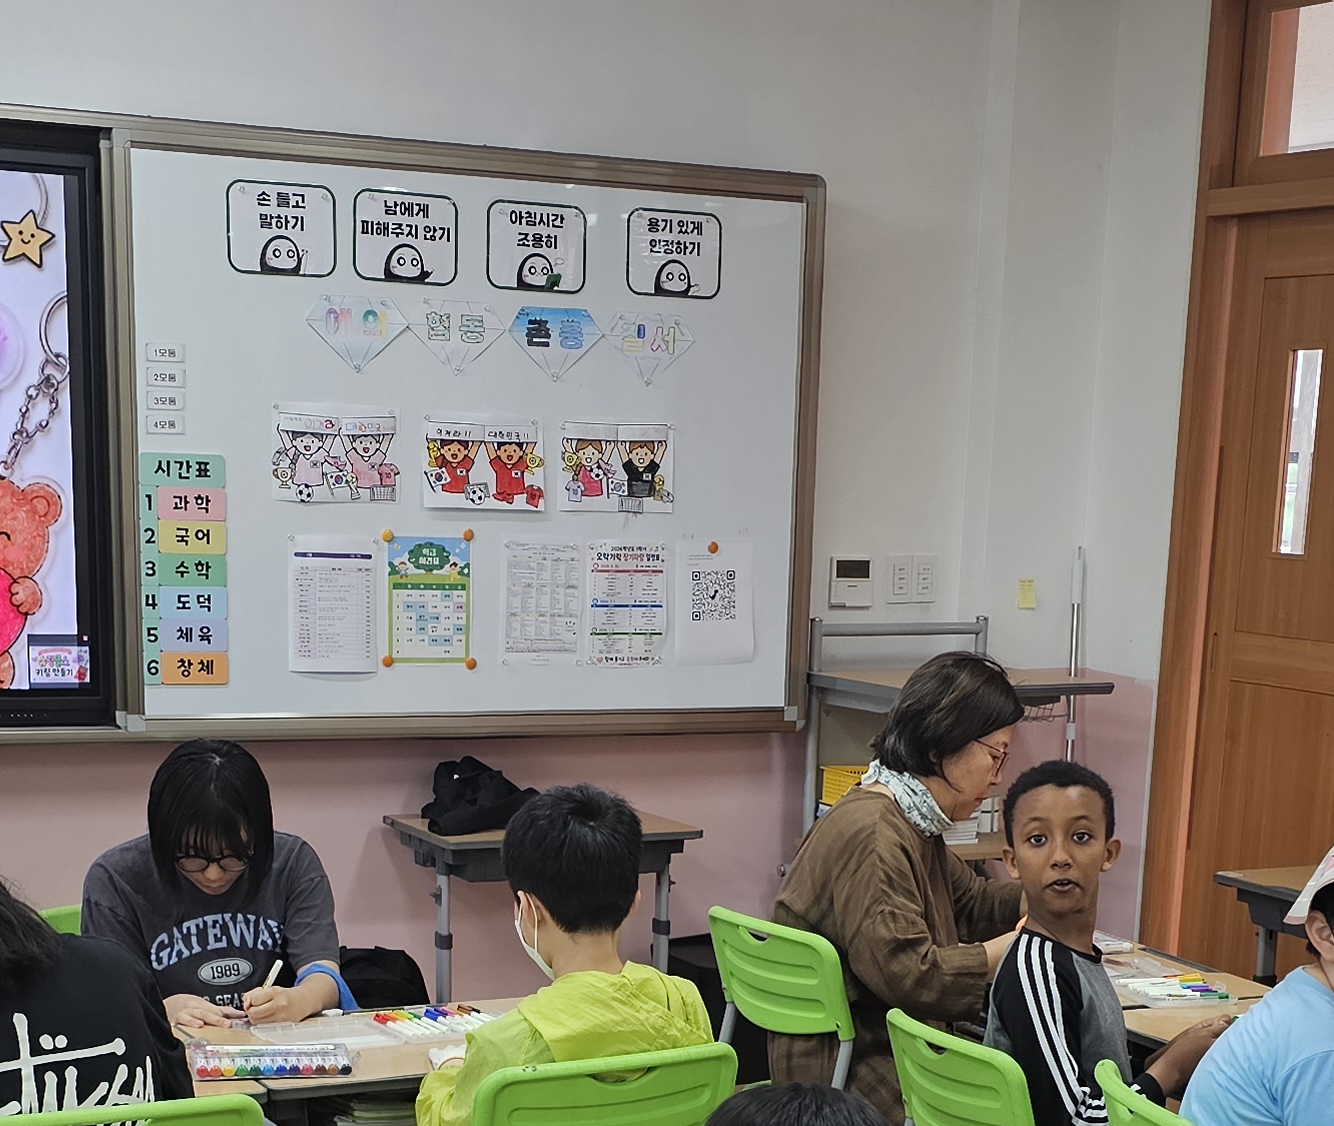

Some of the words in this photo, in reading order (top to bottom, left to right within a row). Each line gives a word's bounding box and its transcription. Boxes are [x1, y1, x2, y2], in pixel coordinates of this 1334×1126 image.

[256, 190, 272, 207] 손
[275, 192, 306, 209] 들고
[383, 199, 430, 219] 남에게
[259, 213, 305, 232] 말하기
[509, 210, 565, 229] 아침시간
[647, 217, 673, 234] 용기
[677, 220, 703, 236] 있게
[360, 220, 419, 240] 피해주지
[423, 224, 451, 242] 않기
[517, 232, 558, 250] 조용히
[649, 238, 701, 256] 인정하기
[154, 460, 212, 479] 시간표
[145, 494, 153, 511] 1
[172, 494, 212, 512] 과학
[144, 528, 156, 545] 2
[175, 528, 211, 547] 국어
[144, 561, 157, 578] 3
[175, 561, 212, 580] 수학
[145, 594, 158, 610] 4
[176, 594, 212, 612] 도덕
[146, 627, 158, 643] 5
[176, 626, 213, 645] 체육
[147, 659, 159, 676] 6
[177, 659, 214, 678] 창체
[210, 963, 241, 980] 1989
